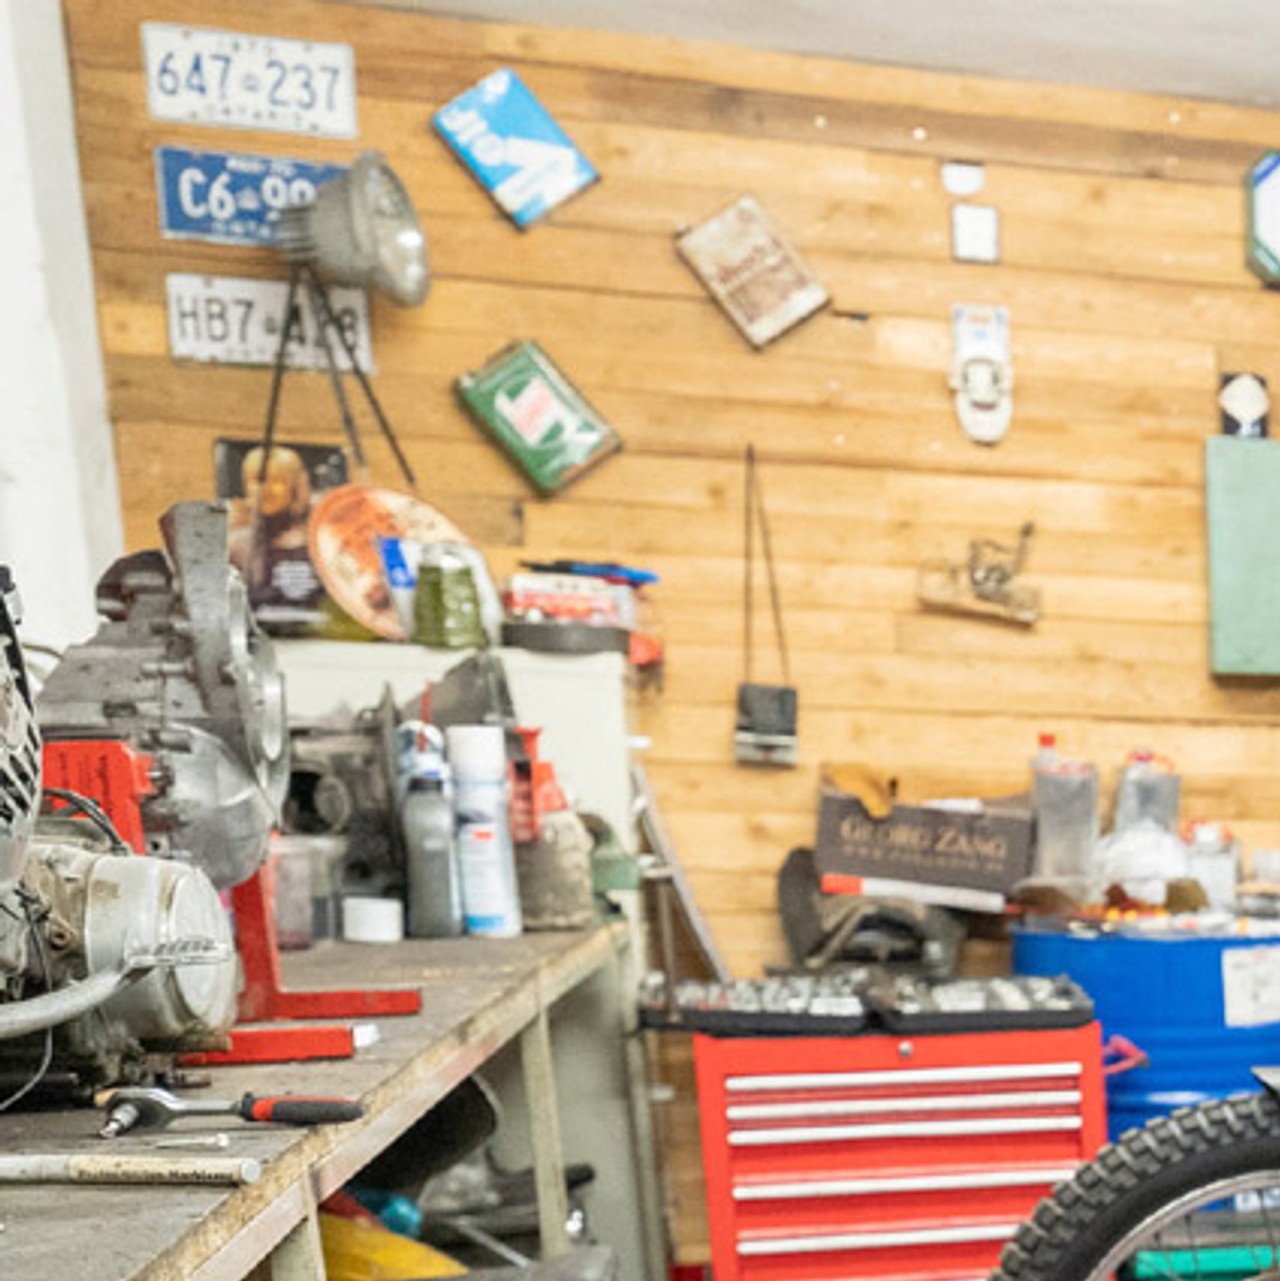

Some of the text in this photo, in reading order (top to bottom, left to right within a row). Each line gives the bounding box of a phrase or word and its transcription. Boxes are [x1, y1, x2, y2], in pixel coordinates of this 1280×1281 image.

[156, 52, 341, 112] 647 237
[177, 295, 254, 343] HB7
